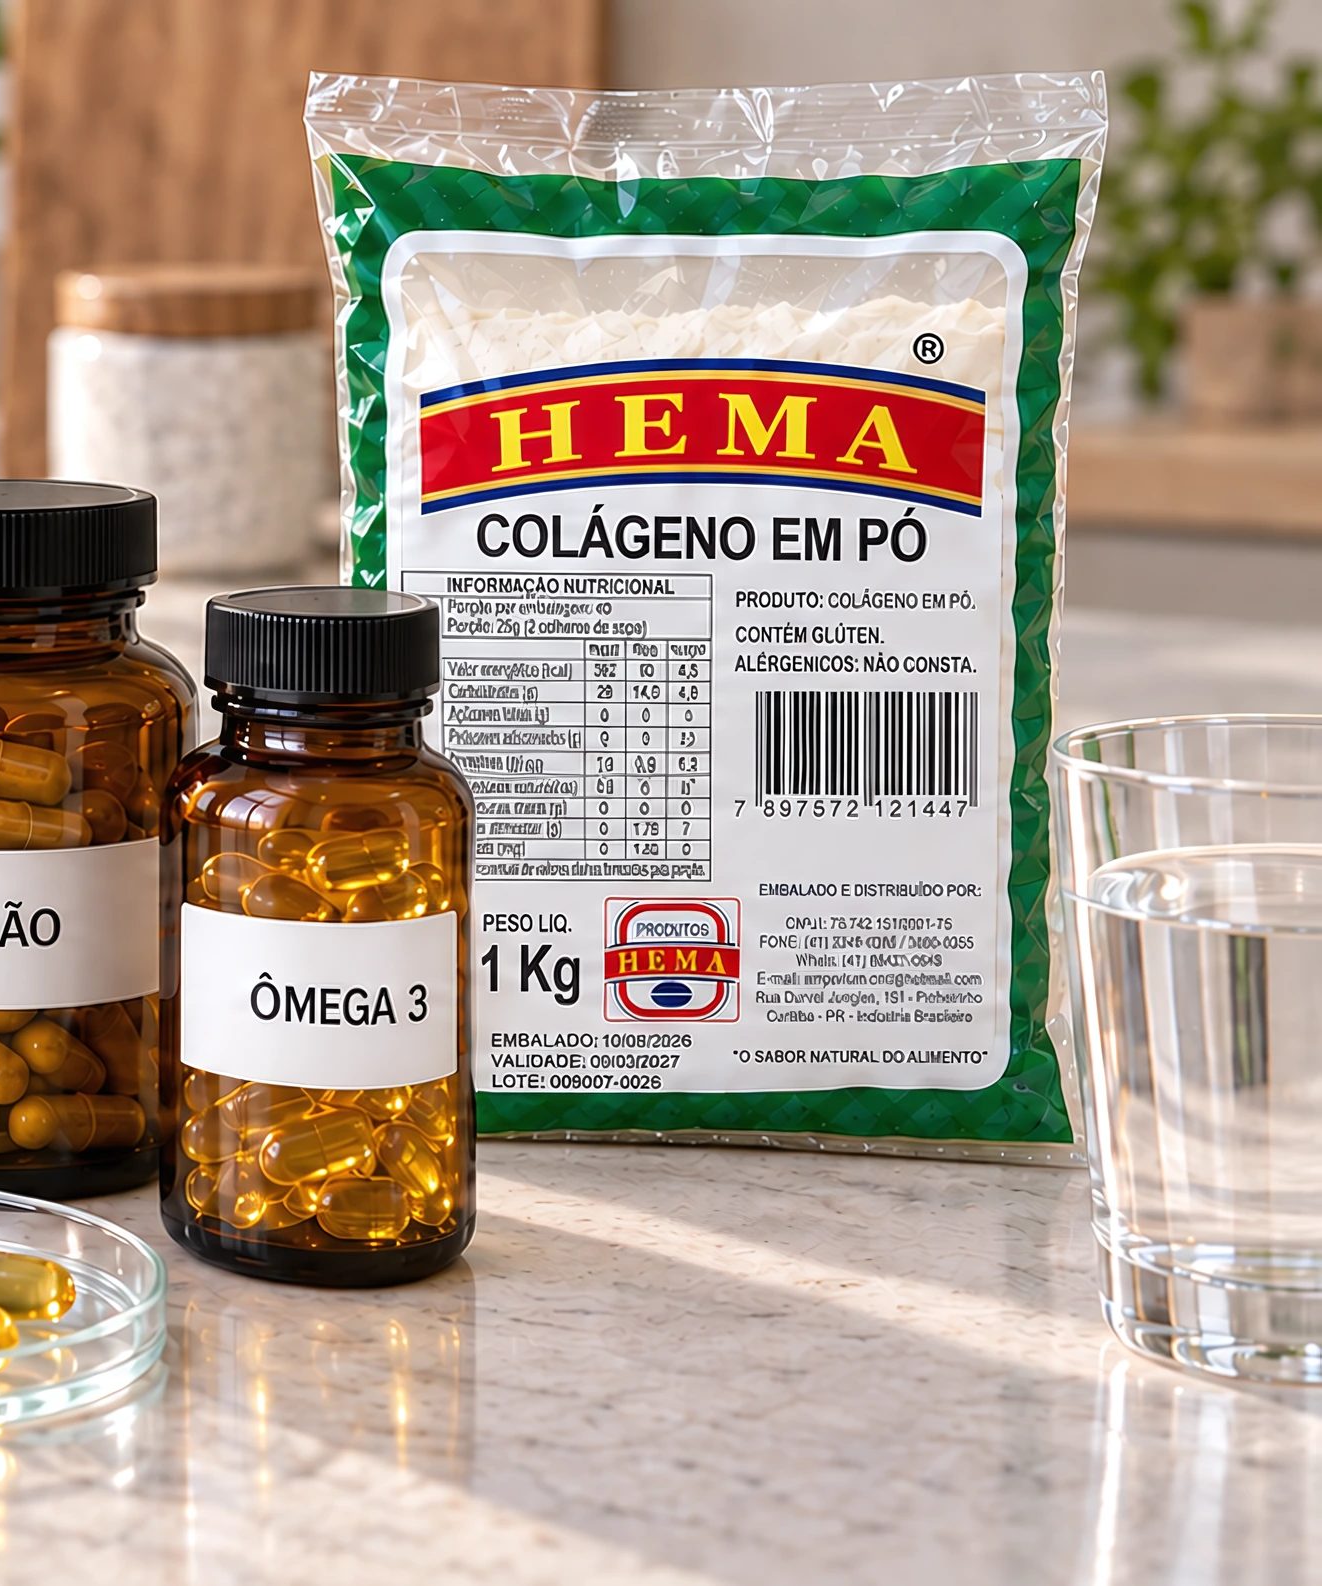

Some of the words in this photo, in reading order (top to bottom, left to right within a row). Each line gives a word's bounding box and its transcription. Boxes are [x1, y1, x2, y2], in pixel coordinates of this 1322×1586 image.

[490, 391, 918, 474] HEMA
[477, 504, 756, 559] COLÁGENO
[772, 517, 841, 561] EM
[859, 507, 926, 562] PÓ
[447, 577, 559, 597] INFORMAÇÃO
[564, 578, 674, 594] NUTRICIONAL
[736, 591, 823, 608] PRODUTO:
[922, 593, 946, 609] EM
[736, 622, 807, 643] CONTÉM
[812, 623, 885, 644] GLÚTEN.
[863, 652, 899, 673] NÃO
[903, 656, 977, 673] CONSTA.
[734, 800, 746, 817] 7
[763, 800, 859, 817] 897572
[875, 800, 968, 817] 121447
[759, 884, 837, 896] EMBALADO
[842, 884, 851, 896] E
[947, 884, 982, 897] POR:
[483, 913, 533, 932] PESO
[539, 913, 572, 933] LIQ.
[618, 950, 727, 974] HEMA
[481, 944, 499, 992] 1
[520, 944, 580, 1006] Kg
[250, 972, 397, 1026] ÔMEGA
[407, 982, 428, 1022] 3
[826, 1010, 845, 1022] PR
[491, 1033, 599, 1048] EMBALADO:
[491, 1054, 586, 1068] VALIDADE:
[755, 1051, 806, 1063] SABOR
[810, 1051, 879, 1063] NATURAL
[882, 1051, 905, 1063] DO
[492, 1074, 546, 1088] LOTE:
